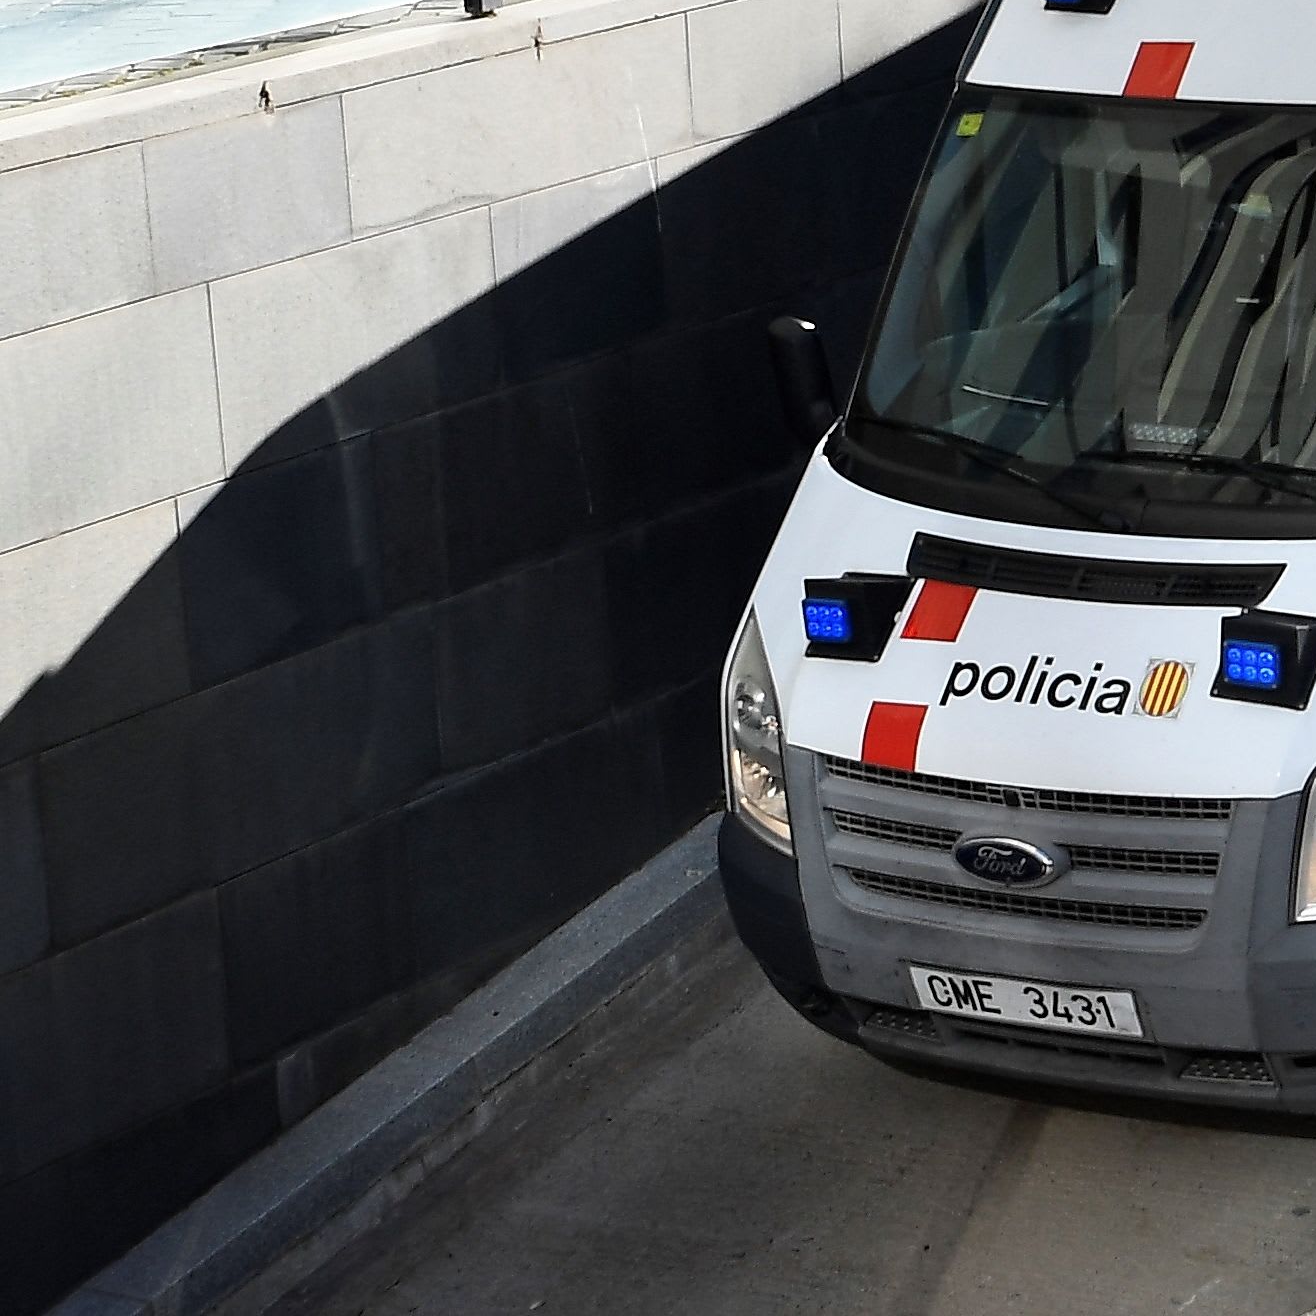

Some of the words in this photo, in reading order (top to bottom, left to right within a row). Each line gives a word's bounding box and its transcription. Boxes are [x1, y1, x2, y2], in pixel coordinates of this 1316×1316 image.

[939, 654, 1132, 716] policia
[973, 845, 1028, 877] Ford
[927, 974, 1002, 1016] CME
[1023, 986, 1116, 1029] 3431
